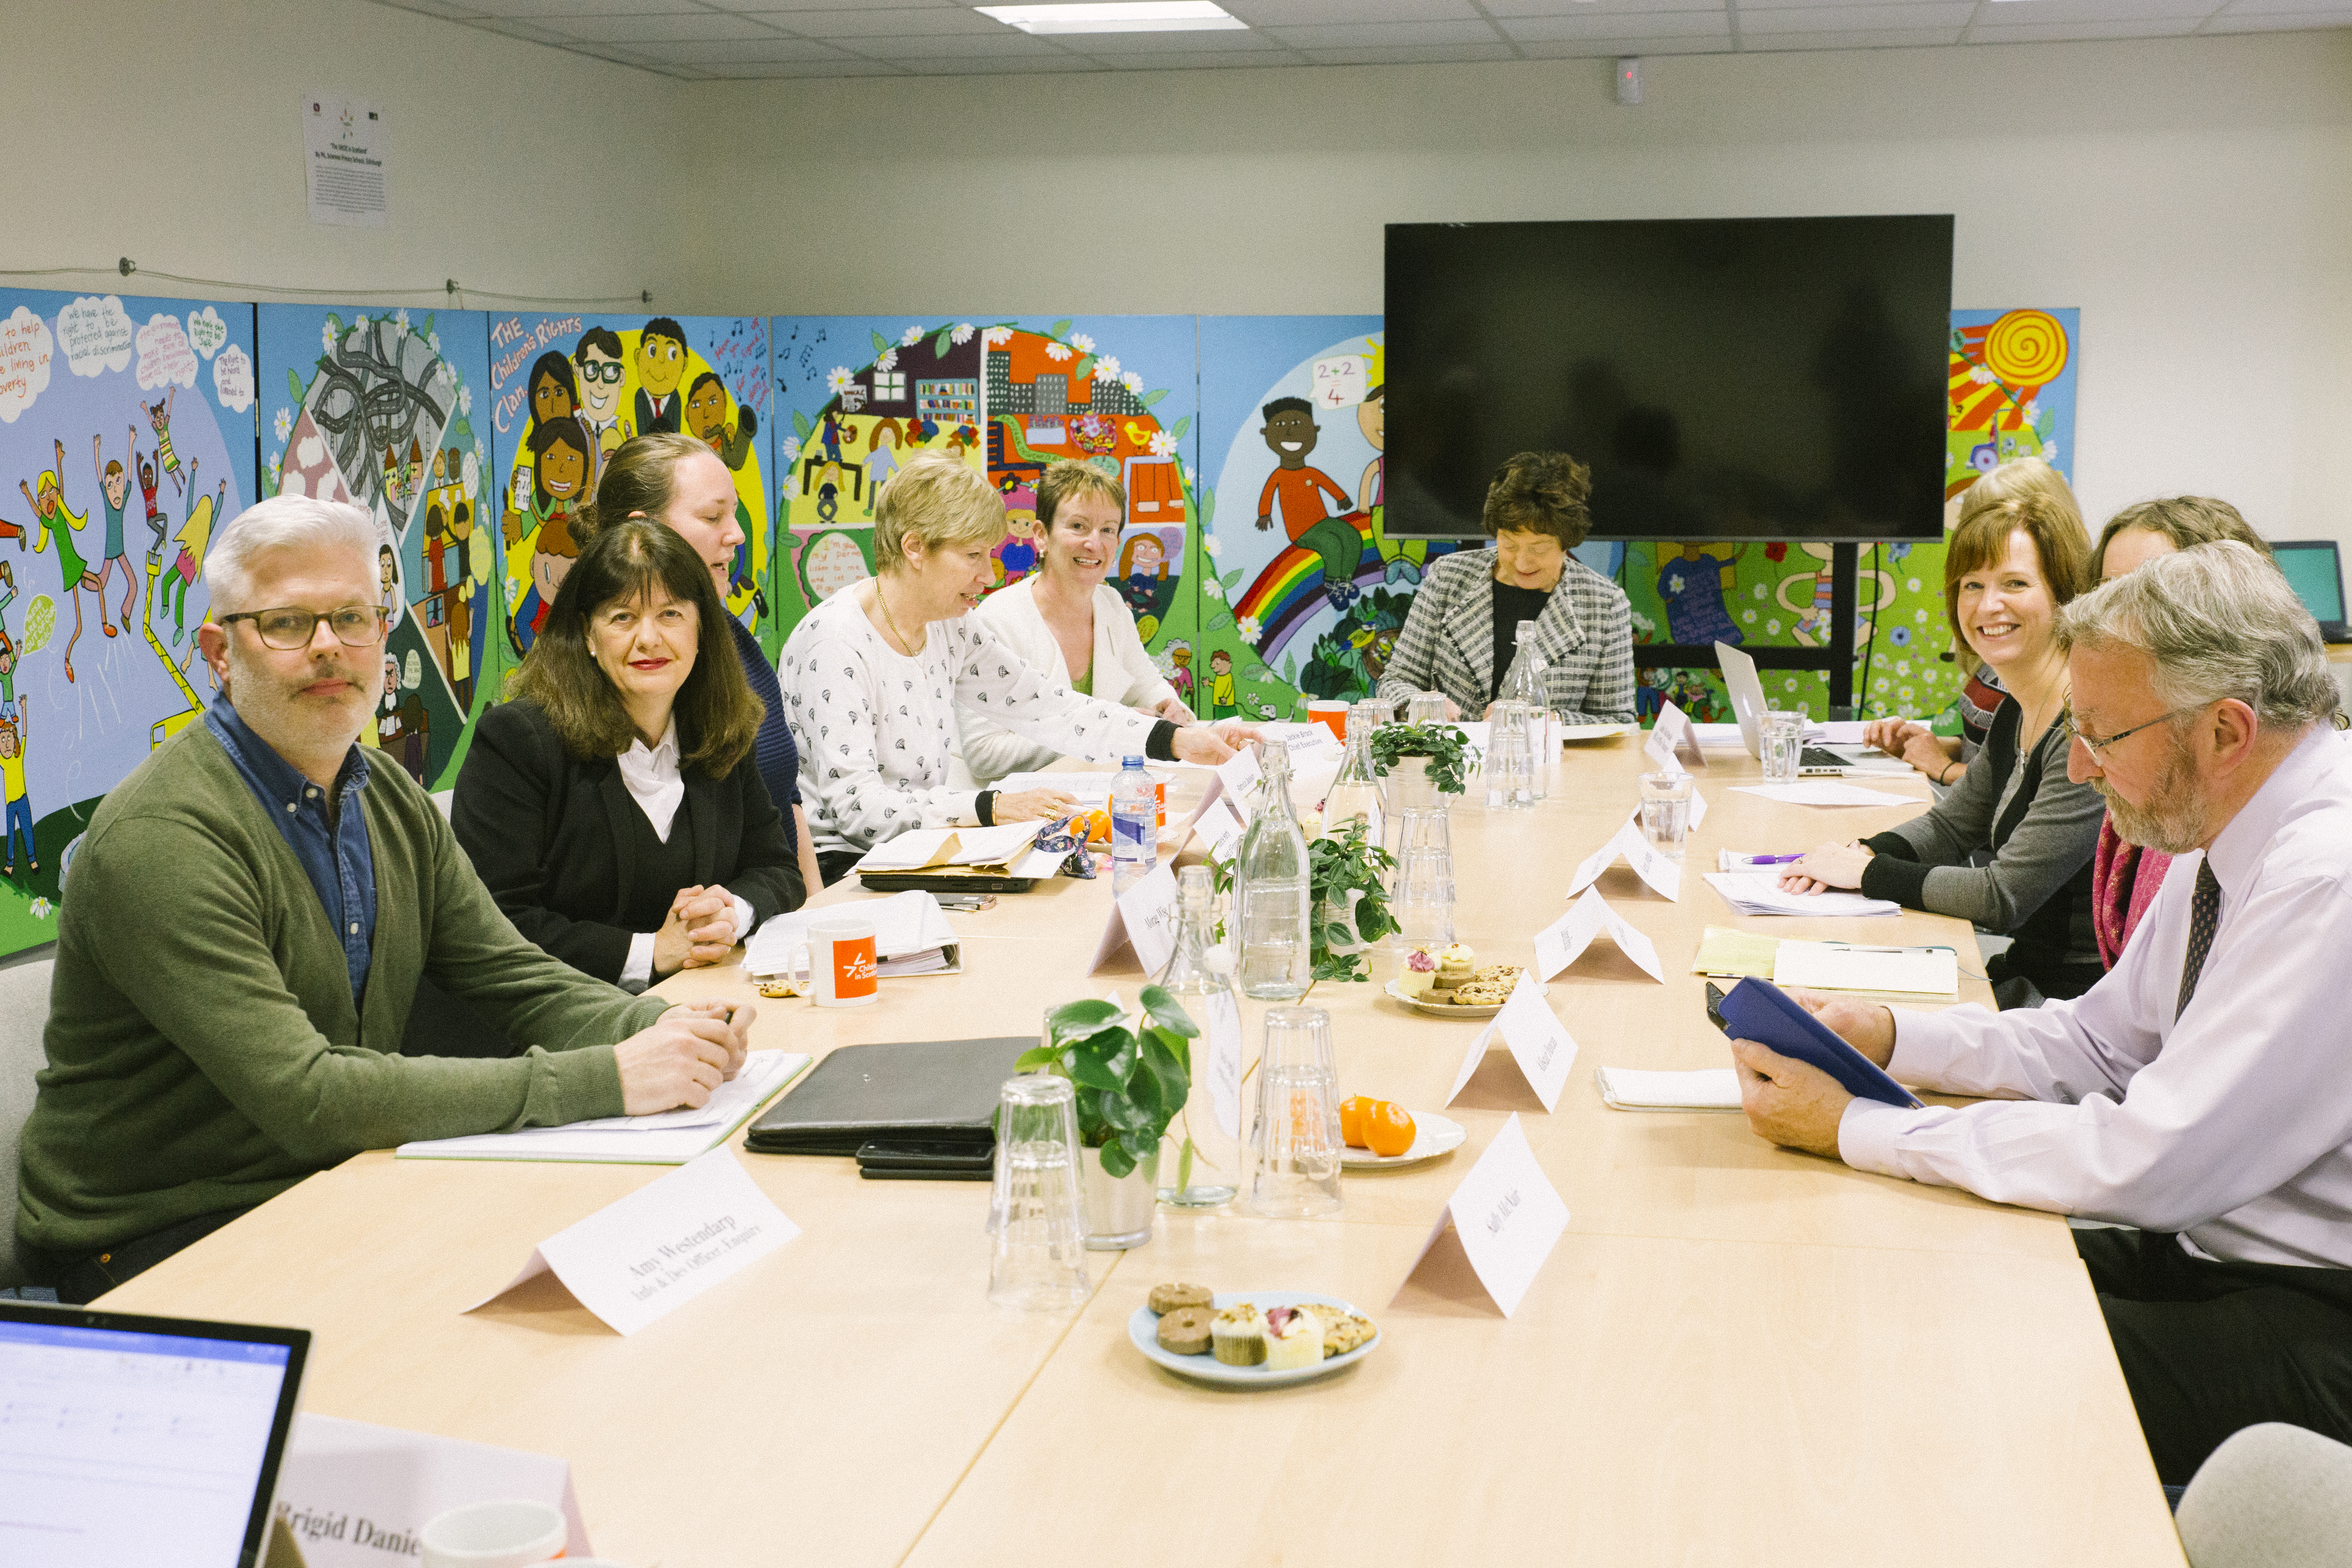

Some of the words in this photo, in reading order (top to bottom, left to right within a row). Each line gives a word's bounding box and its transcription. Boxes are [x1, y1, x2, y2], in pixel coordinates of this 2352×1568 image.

[5, 327, 16, 339] to
[21, 319, 40, 338] help
[490, 316, 524, 349] THE
[11, 358, 35, 372] living
[38, 352, 49, 365] in
[0, 374, 26, 398] overty
[1285, 732, 1301, 741] Jackie
[1300, 729, 1314, 738] Brock
[1288, 742, 1301, 751] Chief
[1300, 739, 1323, 748] Executive
[1144, 914, 1161, 930] Morag
[1156, 906, 1168, 920] Wise
[859, 963, 877, 972] Childre
[628, 1258, 664, 1277] Amy
[657, 1215, 736, 1258] Westendarp
